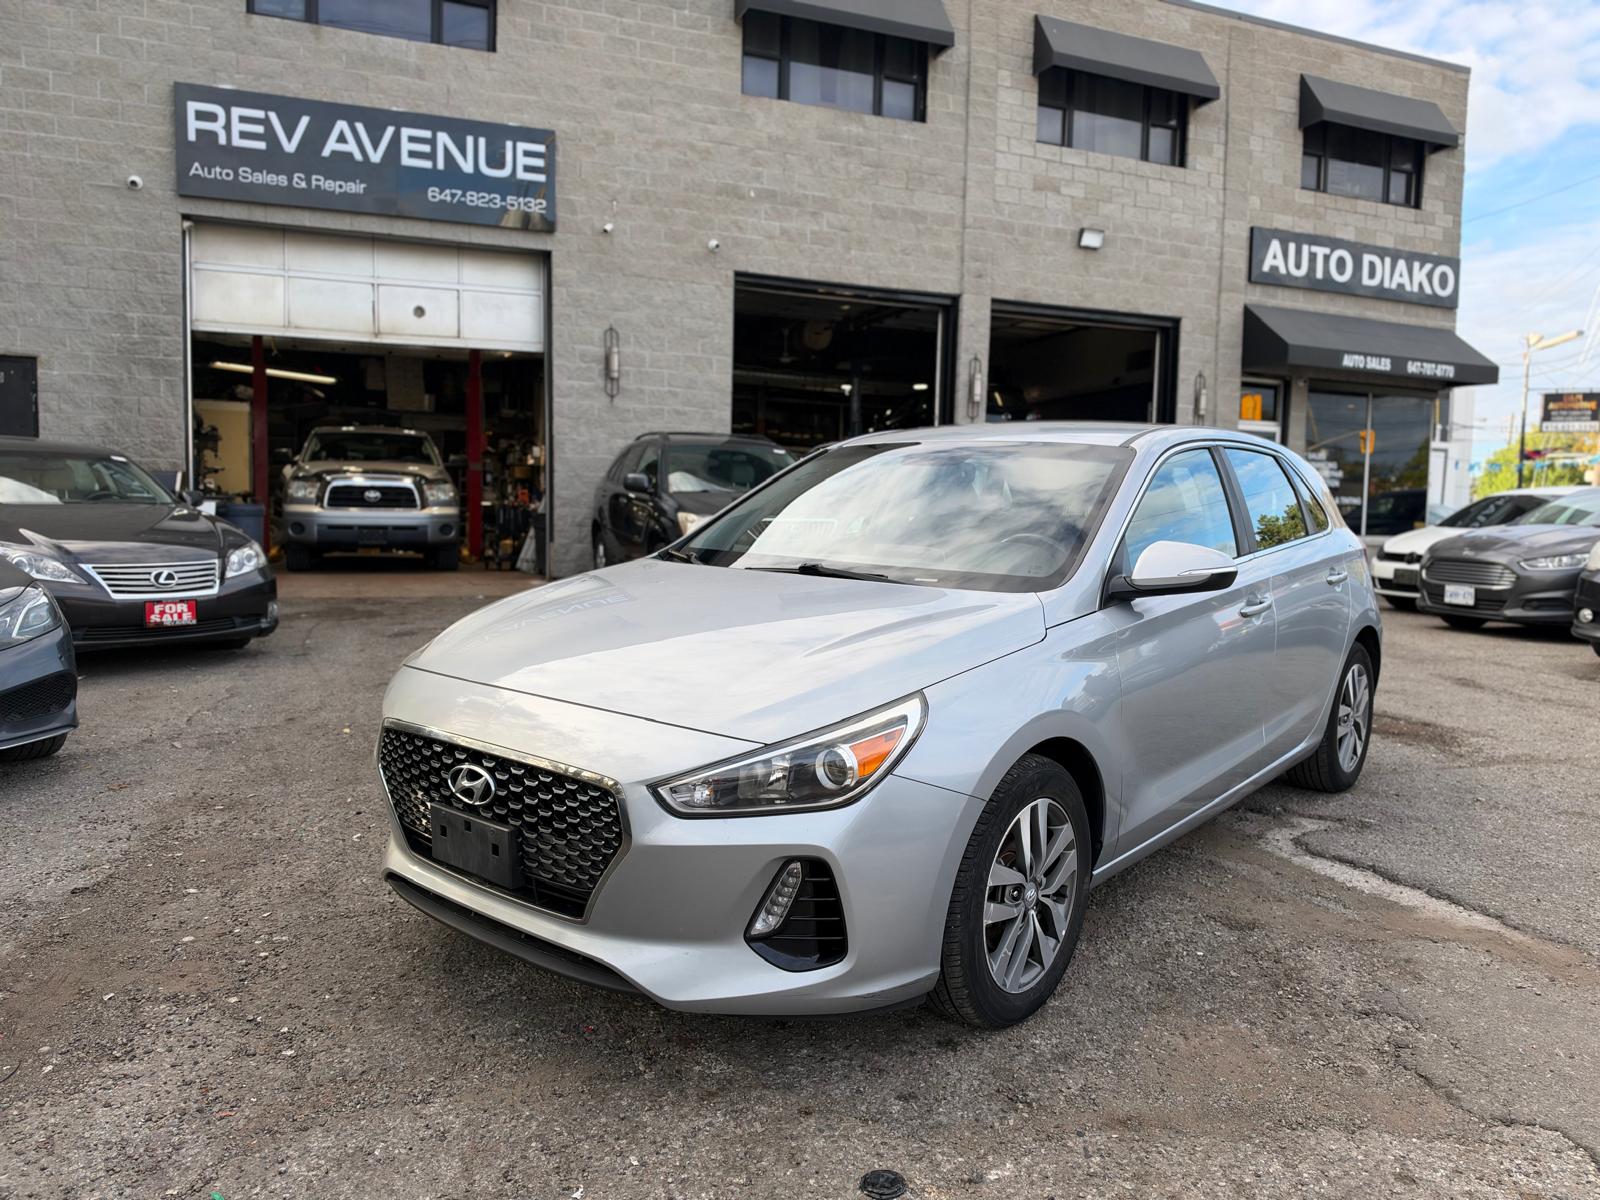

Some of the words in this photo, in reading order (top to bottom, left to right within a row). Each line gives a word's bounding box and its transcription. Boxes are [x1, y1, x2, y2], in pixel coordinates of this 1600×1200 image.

[186, 101, 311, 154] REV
[321, 119, 547, 182] AVENUE
[189, 162, 234, 181] Auto
[238, 167, 288, 187] Sales
[292, 173, 308, 189] &
[311, 175, 367, 195] Repair
[427, 186, 547, 214] 647-823-5132
[1262, 238, 1354, 283] AUTO
[1361, 253, 1456, 298] DIAKO
[1342, 353, 1365, 369] AUTO
[1365, 356, 1392, 372] SALES
[150, 612, 193, 624] SALE
[154, 603, 188, 614] FOR
